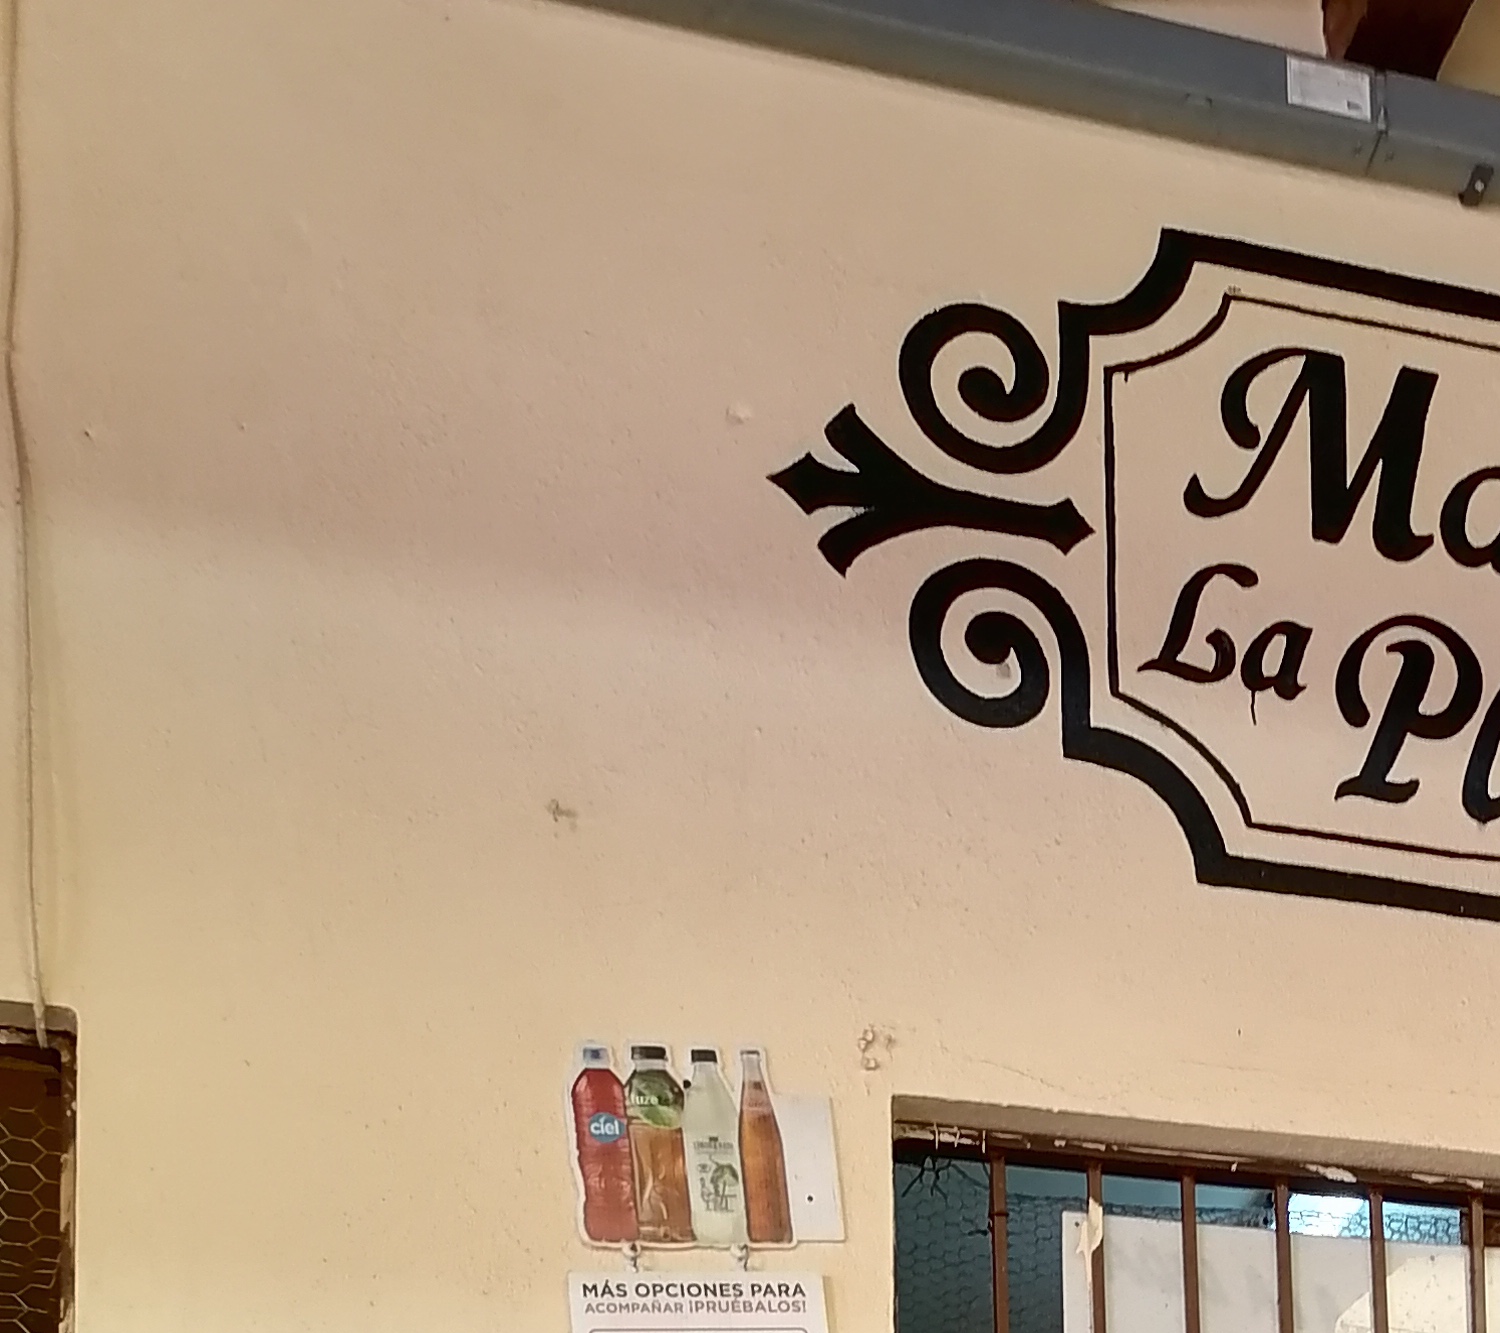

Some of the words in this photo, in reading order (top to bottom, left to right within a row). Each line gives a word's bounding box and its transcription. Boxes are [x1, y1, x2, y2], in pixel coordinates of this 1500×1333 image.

[1137, 562, 1308, 700] La
[582, 1279, 627, 1298] MÁS
[634, 1282, 744, 1298] OPCIONES
[751, 1282, 807, 1298] PARA
[585, 1299, 684, 1314] ACOMPAÑAR
